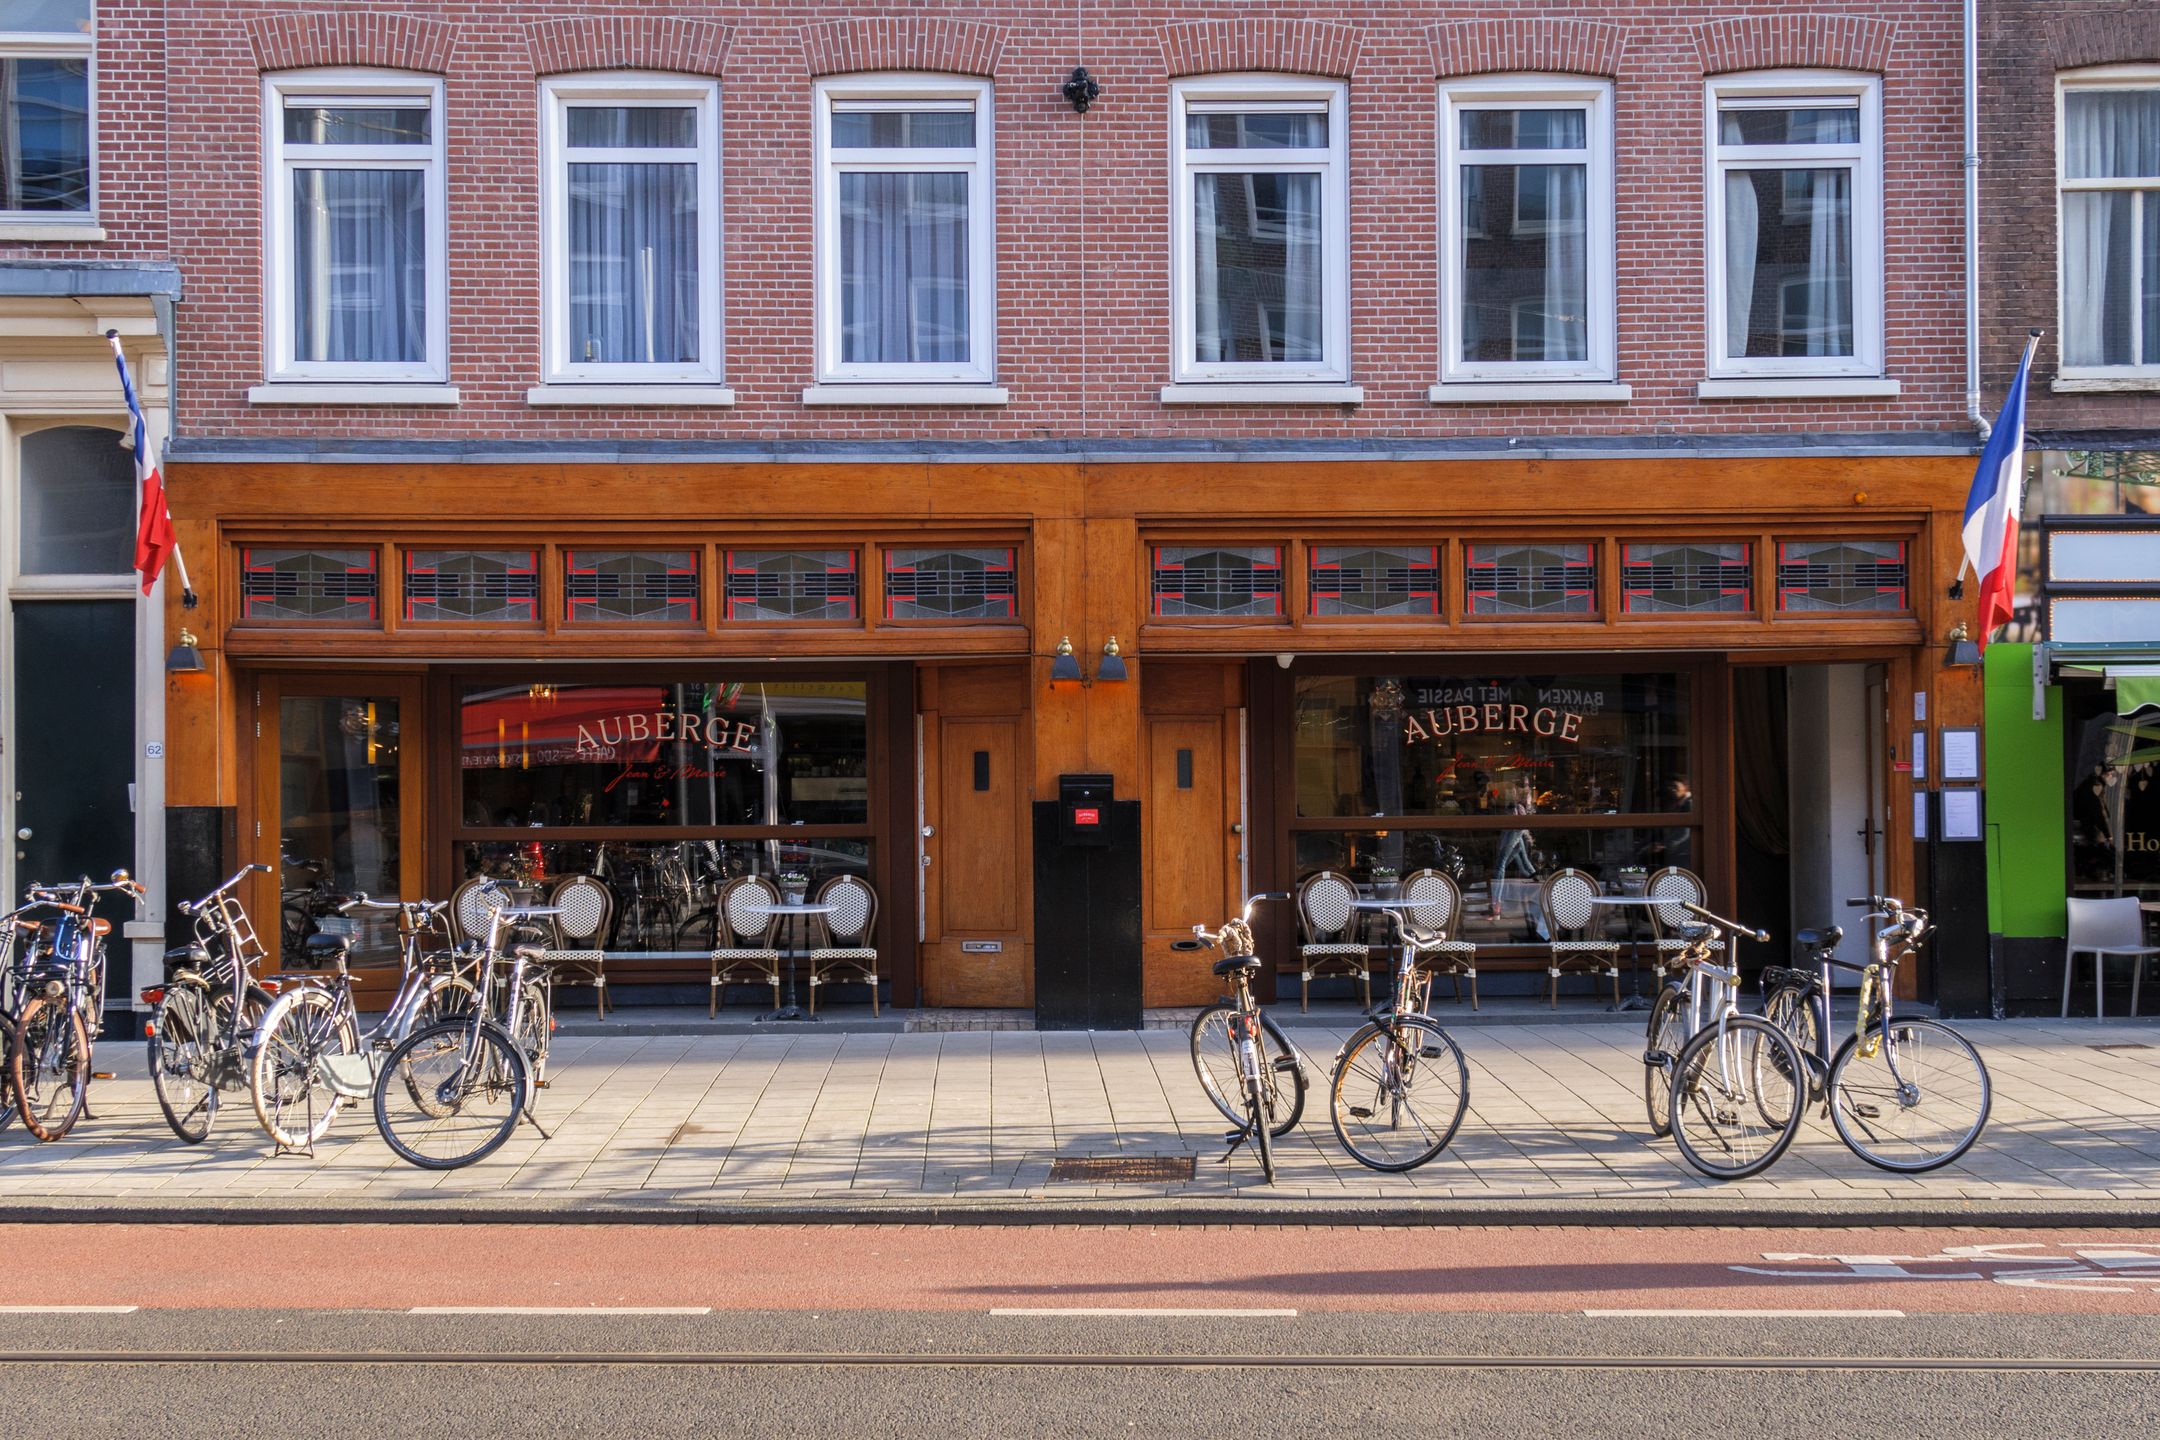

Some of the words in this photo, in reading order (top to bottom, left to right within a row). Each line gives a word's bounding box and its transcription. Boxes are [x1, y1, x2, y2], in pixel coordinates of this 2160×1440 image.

[576, 712, 756, 753] AUBERGE
[1406, 703, 1583, 745] AUBERGE
[148, 745, 162, 755] 62
[604, 762, 649, 793] Jean
[654, 765, 669, 780] &
[669, 763, 727, 780] Marie
